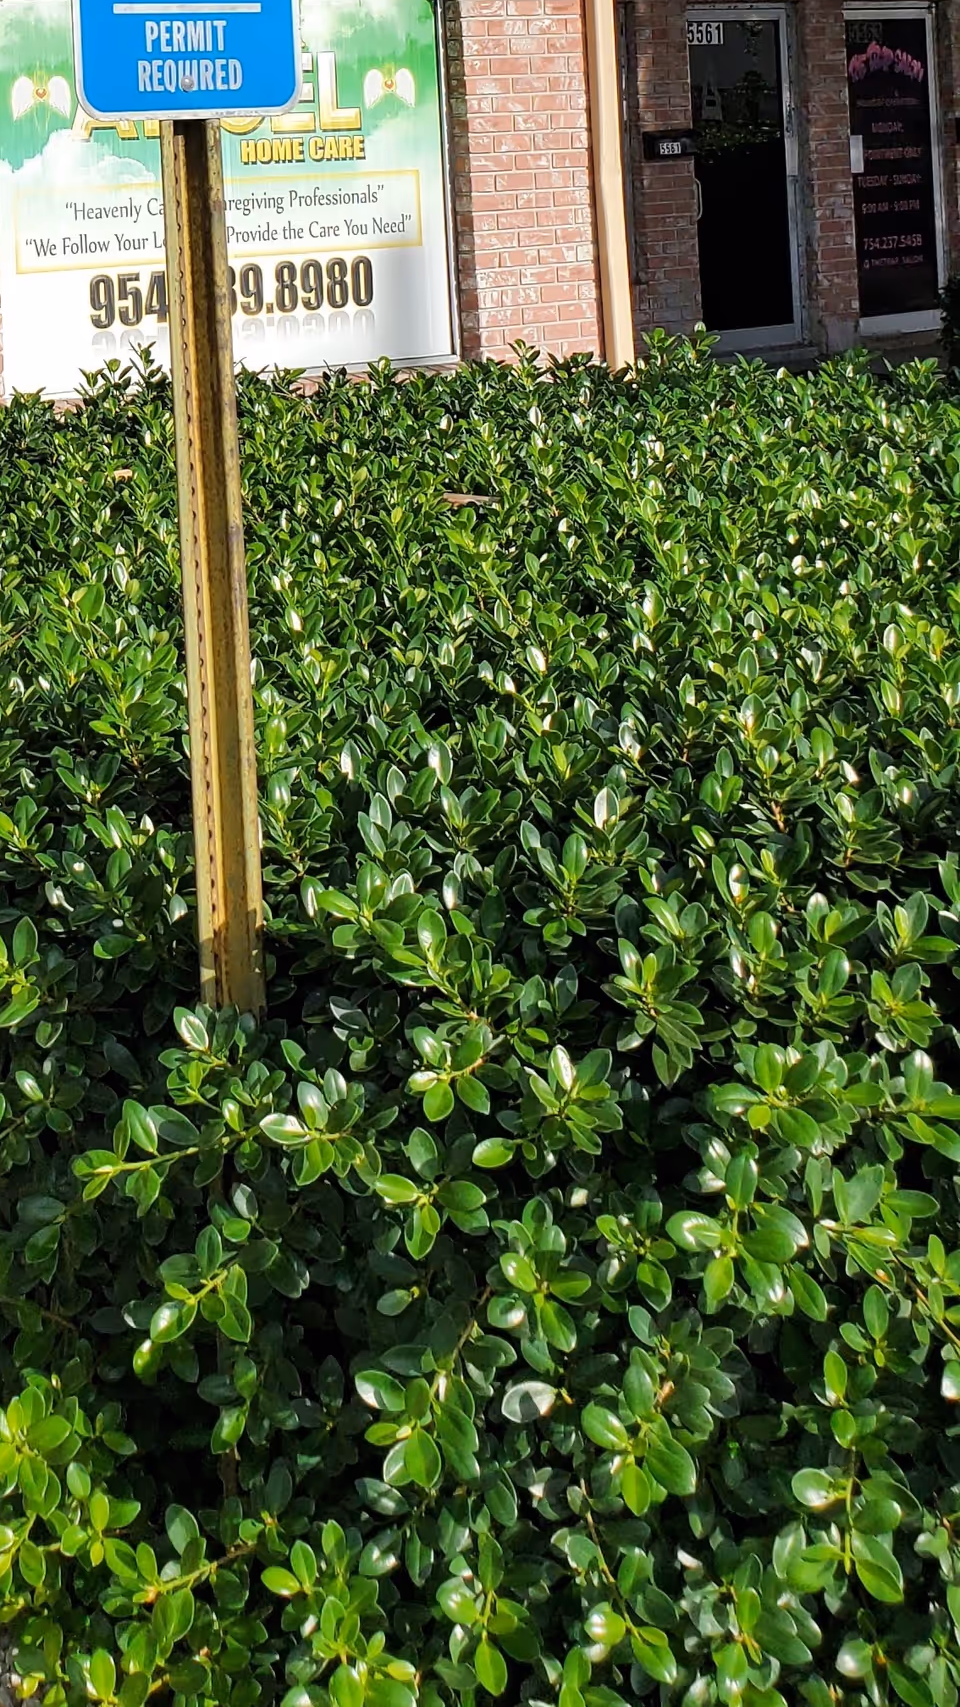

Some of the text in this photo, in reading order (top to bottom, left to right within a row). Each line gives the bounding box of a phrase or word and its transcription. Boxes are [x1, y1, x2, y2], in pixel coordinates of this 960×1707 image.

[145, 20, 227, 53] PERMIT
[687, 22, 722, 44] 5561
[137, 59, 244, 92] REQUIRED
[240, 134, 366, 166] HOME CARE
[65, 197, 142, 224] “Heavenly
[223, 191, 284, 216] regiving
[289, 183, 385, 208] Professionals”
[62, 233, 110, 255] Follow
[114, 232, 149, 252] Your
[226, 213, 412, 244] Provide the Care You Need”
